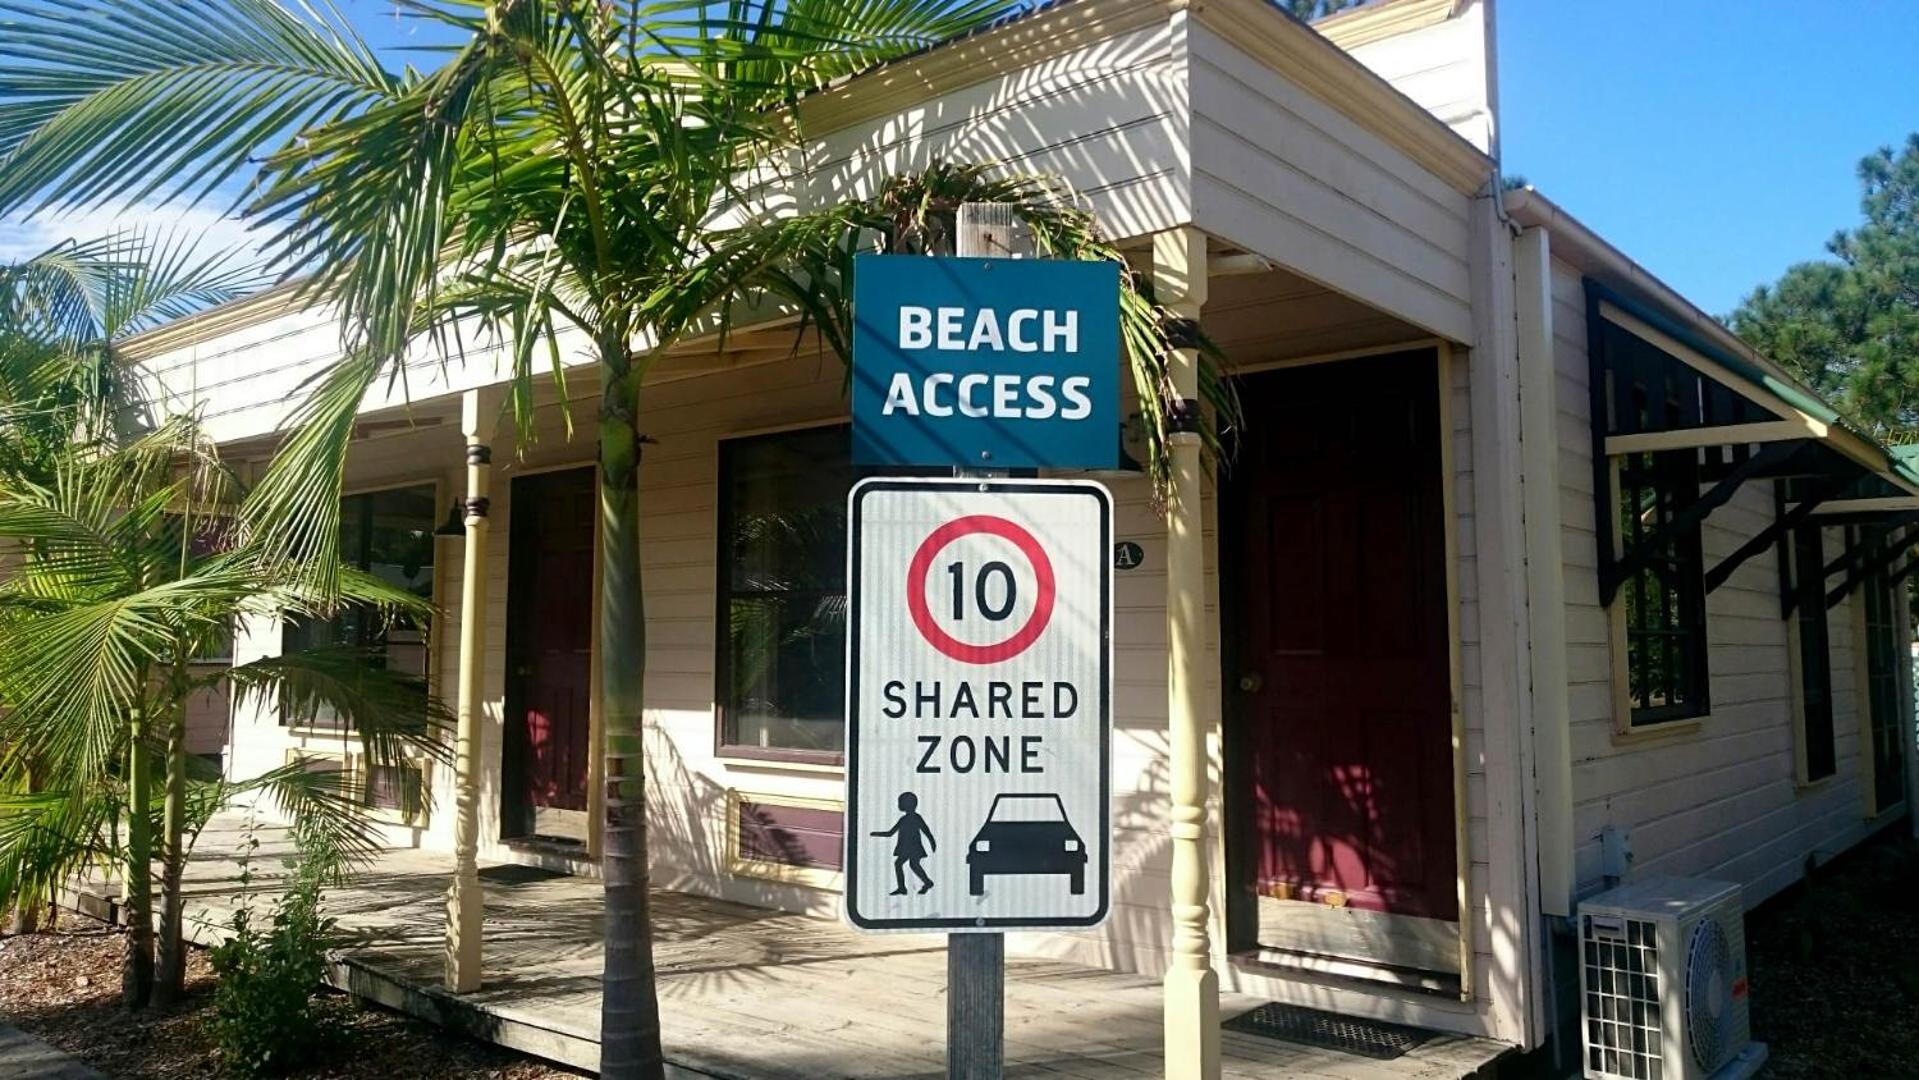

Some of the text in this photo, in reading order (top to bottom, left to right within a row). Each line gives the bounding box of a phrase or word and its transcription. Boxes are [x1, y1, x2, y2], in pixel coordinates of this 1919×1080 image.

[900, 306, 1078, 352] BEACH
[882, 373, 1092, 420] ACCESS
[1115, 544, 1136, 565] A
[948, 561, 1017, 621] 10
[882, 680, 1078, 719] SHARED
[916, 735, 1044, 774] ZONE
